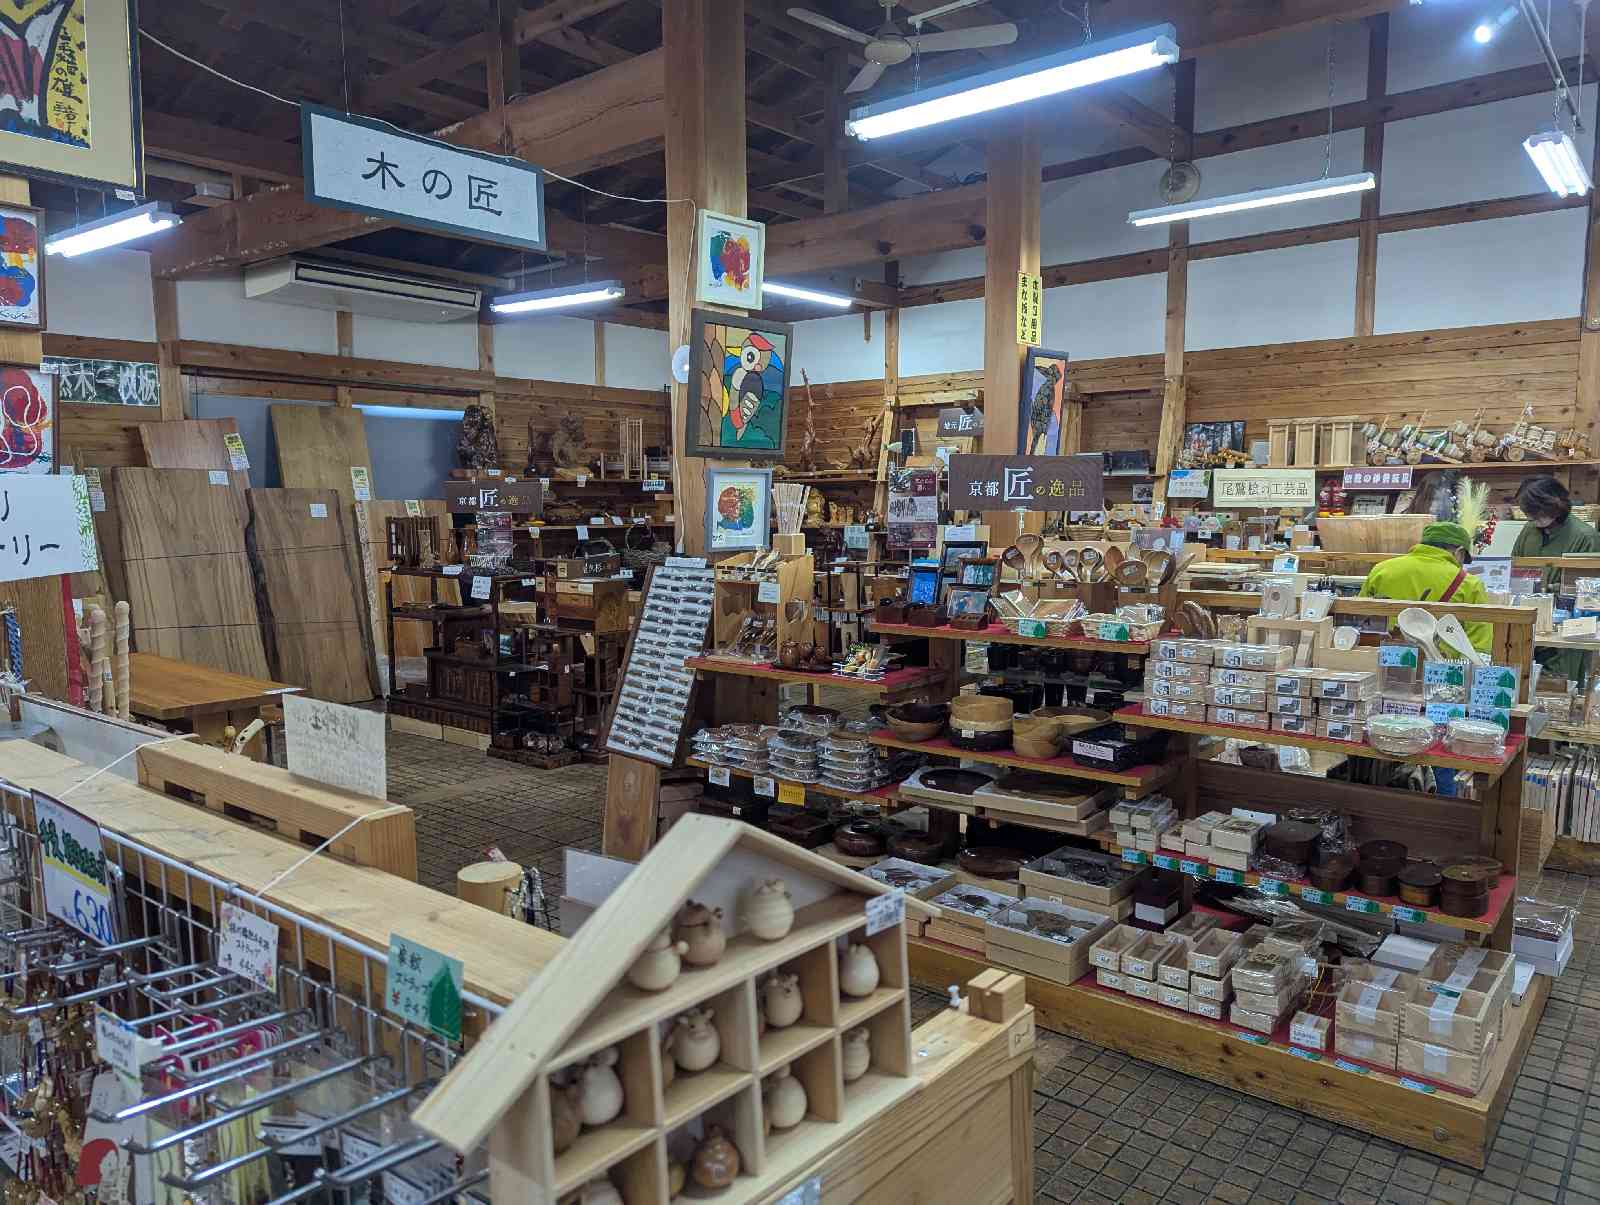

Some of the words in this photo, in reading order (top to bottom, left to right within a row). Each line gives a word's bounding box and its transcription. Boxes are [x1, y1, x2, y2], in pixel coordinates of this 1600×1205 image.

[360, 151, 503, 217] 木の匠
[967, 466, 1086, 502] 京都匠の逸品
[0, 534, 61, 566] リー
